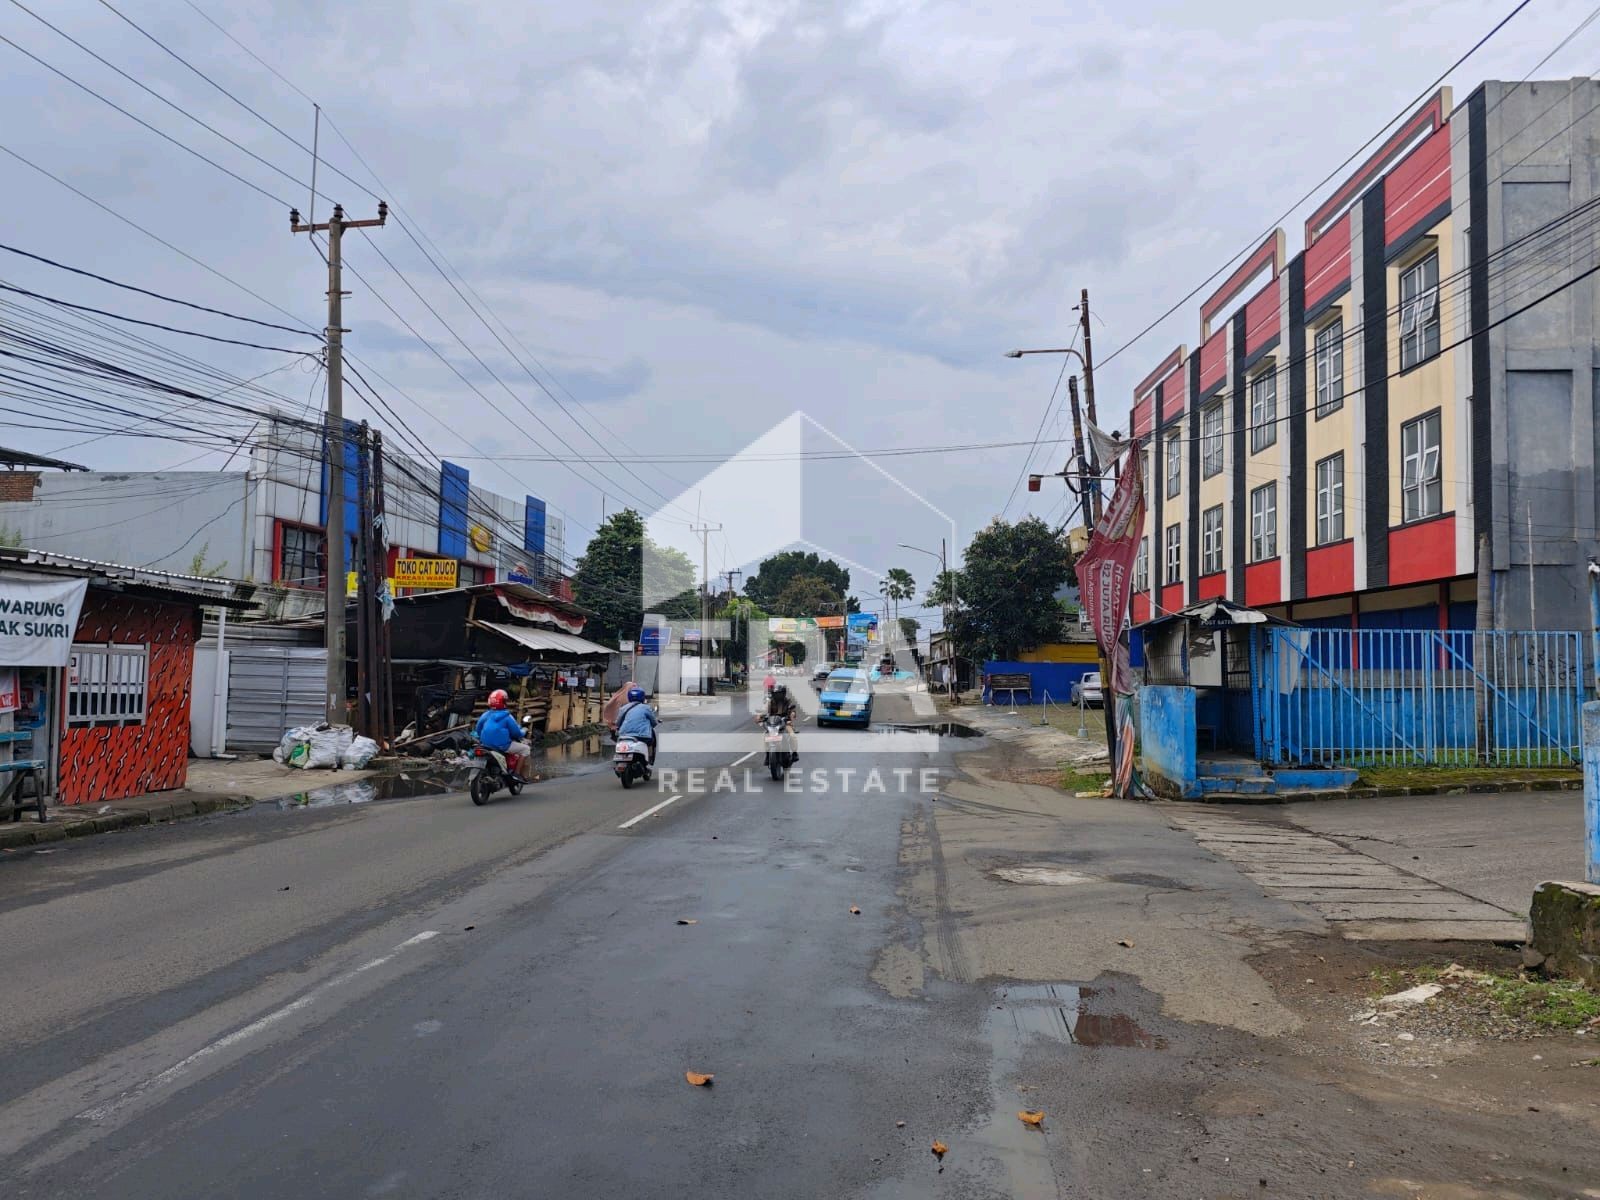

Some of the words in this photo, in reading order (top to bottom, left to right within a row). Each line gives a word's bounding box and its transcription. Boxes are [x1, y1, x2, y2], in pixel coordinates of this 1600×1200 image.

[397, 560, 416, 574] TOKO
[419, 560, 433, 575] CAT
[435, 561, 455, 575] DUCO
[1102, 563, 1111, 577] 82
[1102, 581, 1112, 612] JUTA
[0, 599, 65, 618] WARUNG
[24, 622, 69, 638] SUKRI
